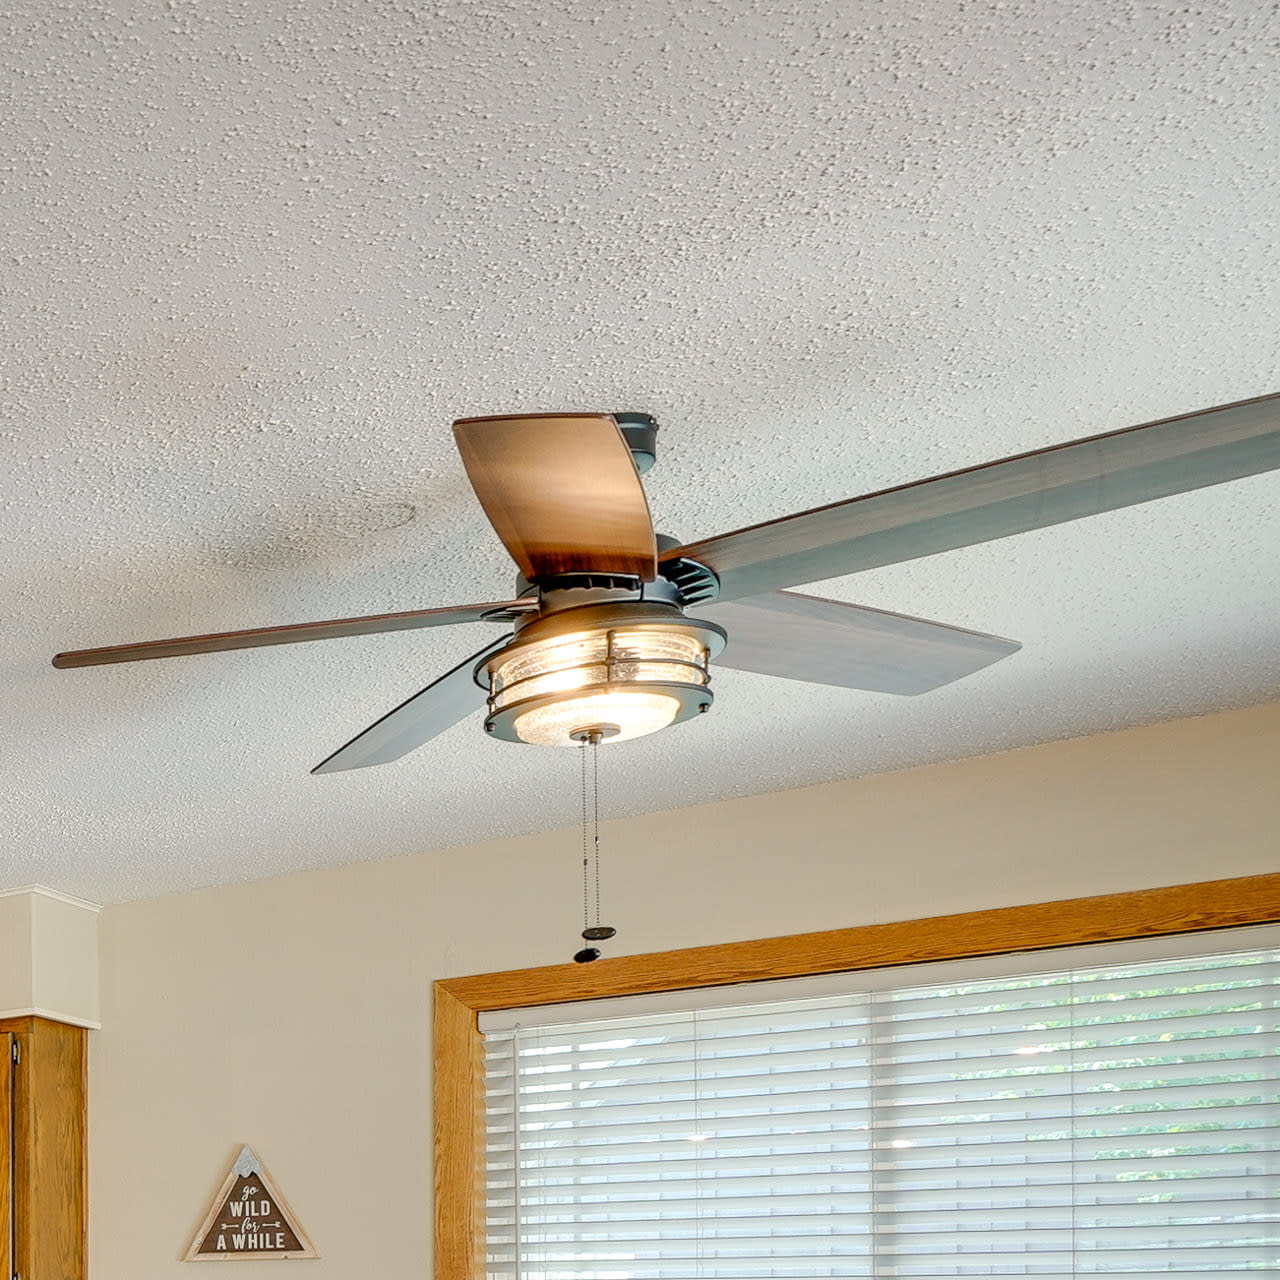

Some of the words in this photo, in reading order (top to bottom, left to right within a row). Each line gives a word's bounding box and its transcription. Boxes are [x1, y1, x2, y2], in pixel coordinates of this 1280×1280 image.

[241, 1185, 259, 1201] go
[229, 1200, 271, 1217] WILD
[241, 1217, 260, 1234] for
[216, 1234, 227, 1250] A
[232, 1232, 286, 1249] WHILE
